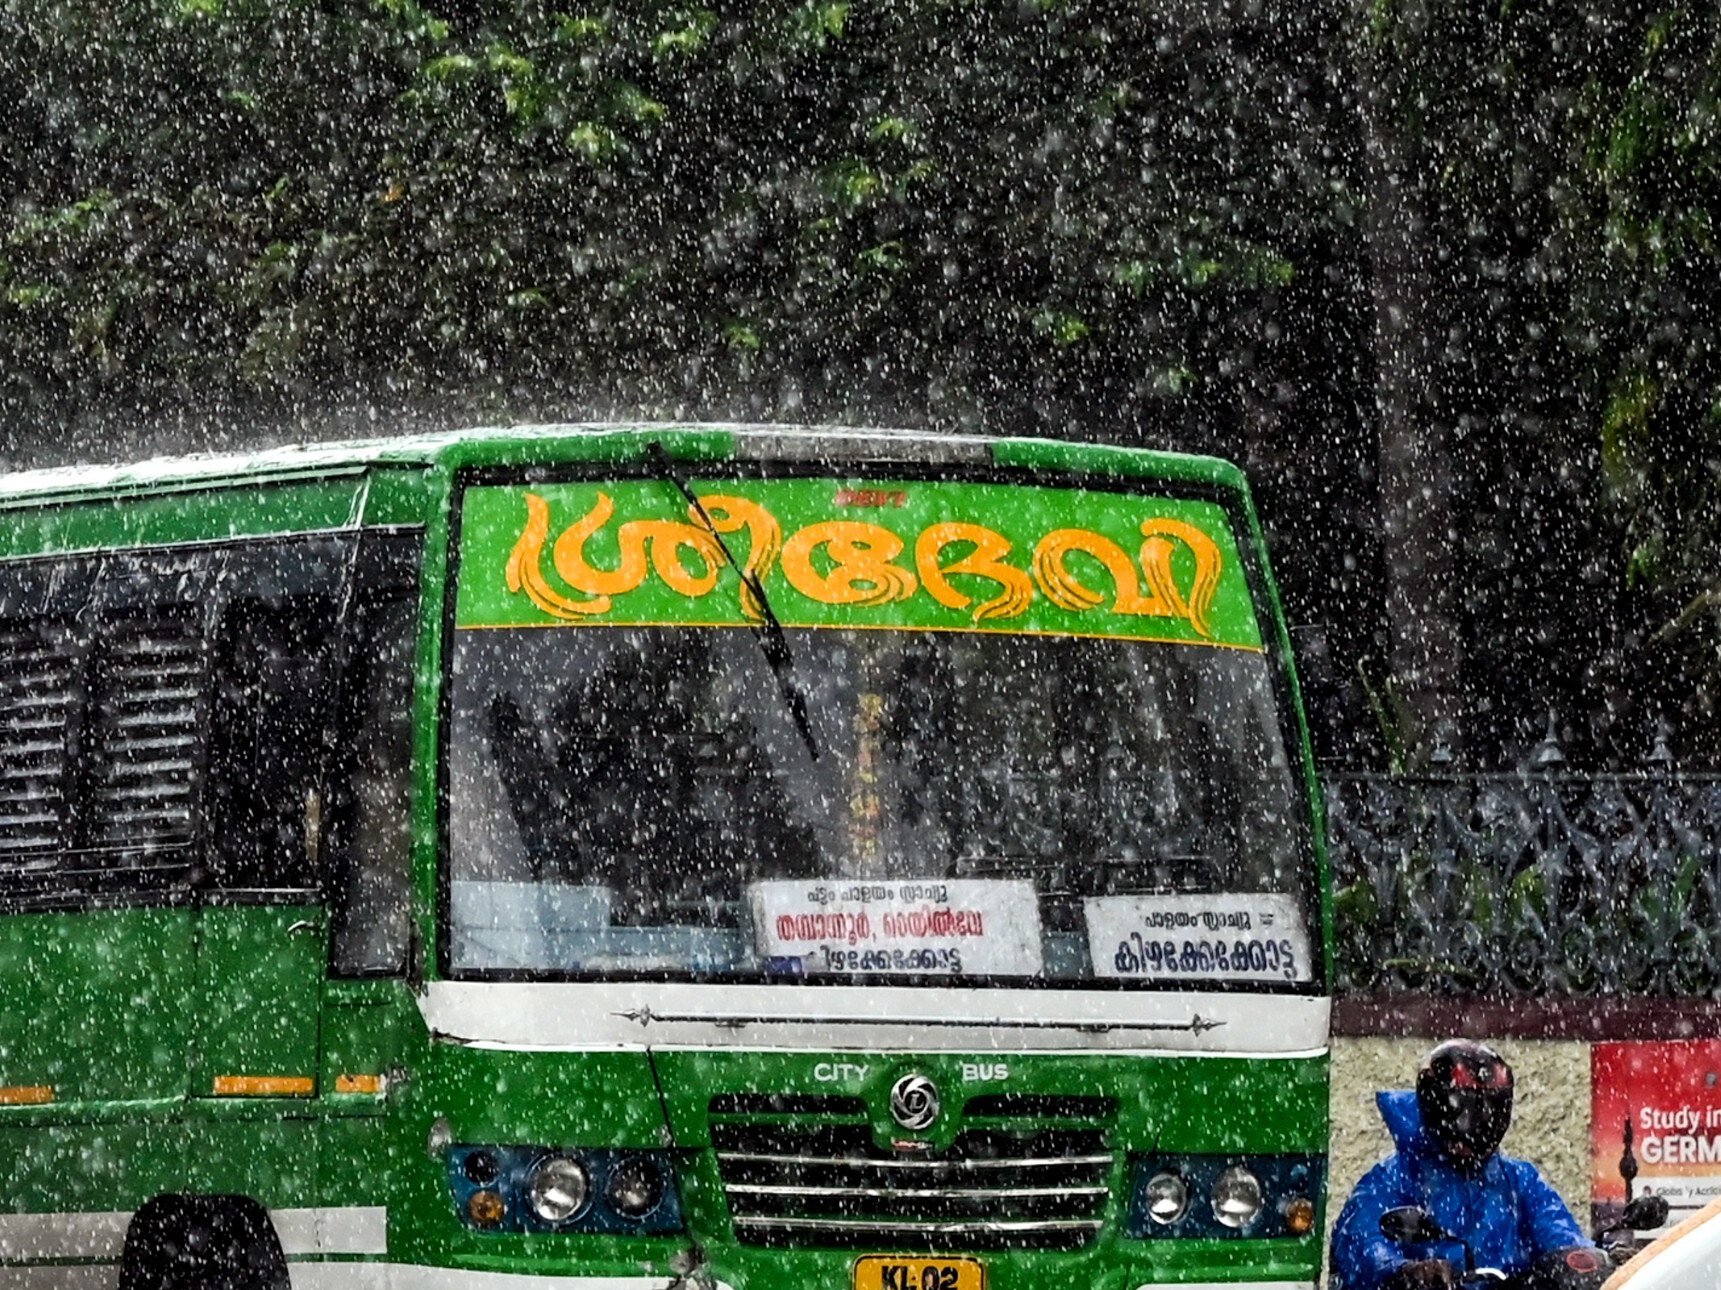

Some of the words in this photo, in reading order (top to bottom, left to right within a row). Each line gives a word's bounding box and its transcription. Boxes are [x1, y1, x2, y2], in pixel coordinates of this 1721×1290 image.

[506, 493, 1223, 638] ശ്രീദേവി
[814, 1063, 870, 1081] CITY
[962, 1063, 1009, 1080] BUS
[1640, 1106, 1700, 1134] Study
